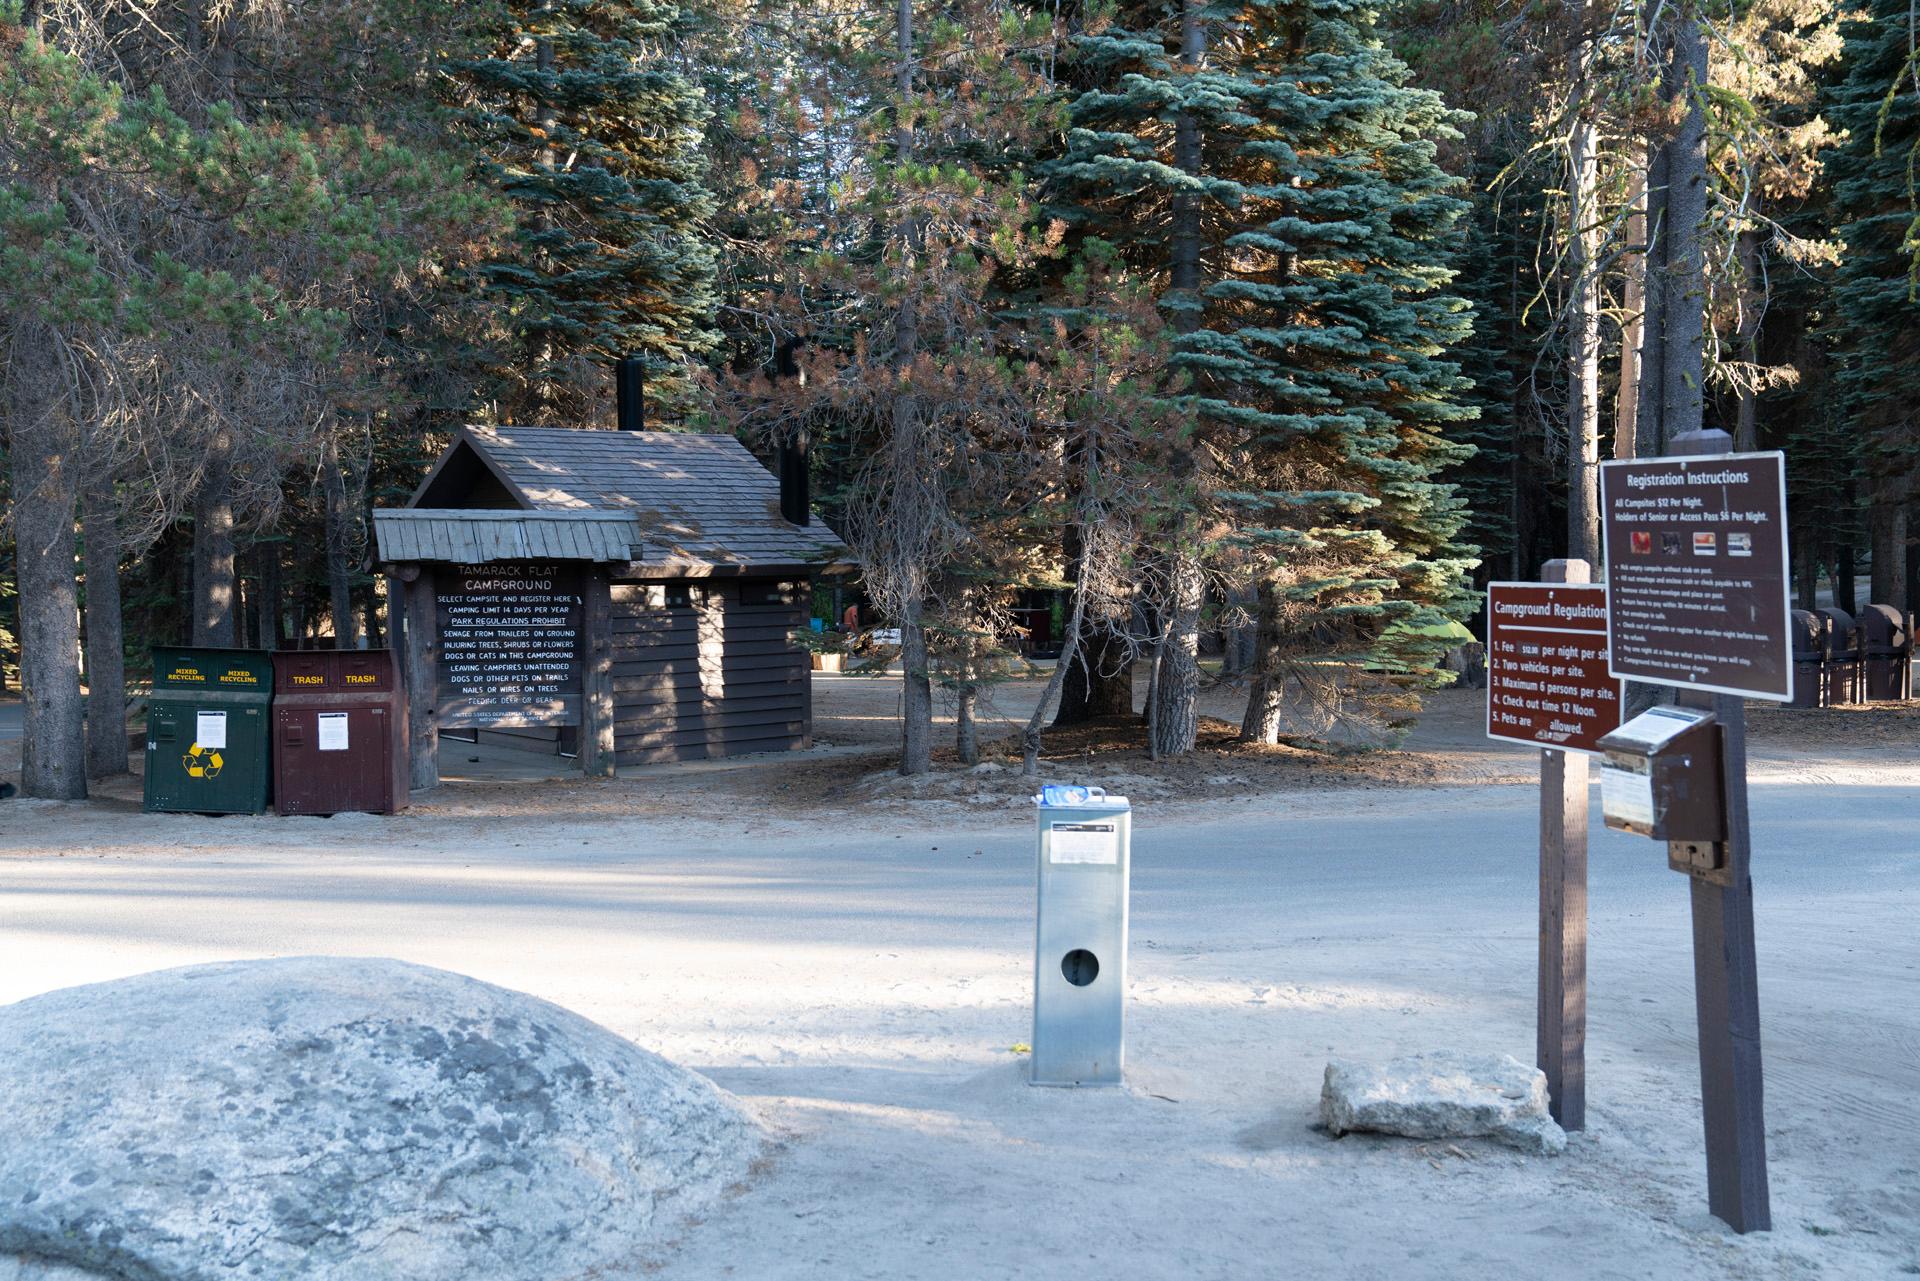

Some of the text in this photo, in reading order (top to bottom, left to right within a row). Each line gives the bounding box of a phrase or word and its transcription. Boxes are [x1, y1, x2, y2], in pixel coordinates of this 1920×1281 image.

[1627, 469, 1748, 490] Registration Instructions
[1615, 498, 1703, 509] All Campsites $12 Per Night.
[1615, 512, 1638, 522] Holders
[1640, 512, 1648, 521] of
[1648, 512, 1668, 521] Senior
[1680, 512, 1701, 522] Access
[1704, 512, 1718, 522] Pass
[1720, 511, 1729, 522] $6
[1732, 512, 1744, 521] Per
[1746, 512, 1768, 524] Night.
[458, 566, 559, 576] TAMARACK FLAT
[466, 580, 552, 590] CAMPGROUND
[1494, 601, 1606, 620] Campground Regulation
[1494, 642, 1499, 650] 1.
[1502, 642, 1514, 652] Fee
[1542, 646, 1555, 657] per
[1558, 646, 1578, 660] night
[1581, 650, 1594, 660] per
[1598, 650, 1608, 660] sit
[1494, 659, 1584, 677] 2. Two vehicles per site.
[294, 676, 324, 684] TRASH
[346, 675, 376, 684] TRASH
[1494, 676, 1616, 700] 3. Maximum 6 persons per site.
[1493, 695, 1597, 717] 4. Check out time 12 Noon.
[1492, 712, 1584, 734] 5. Pets are allowed.
